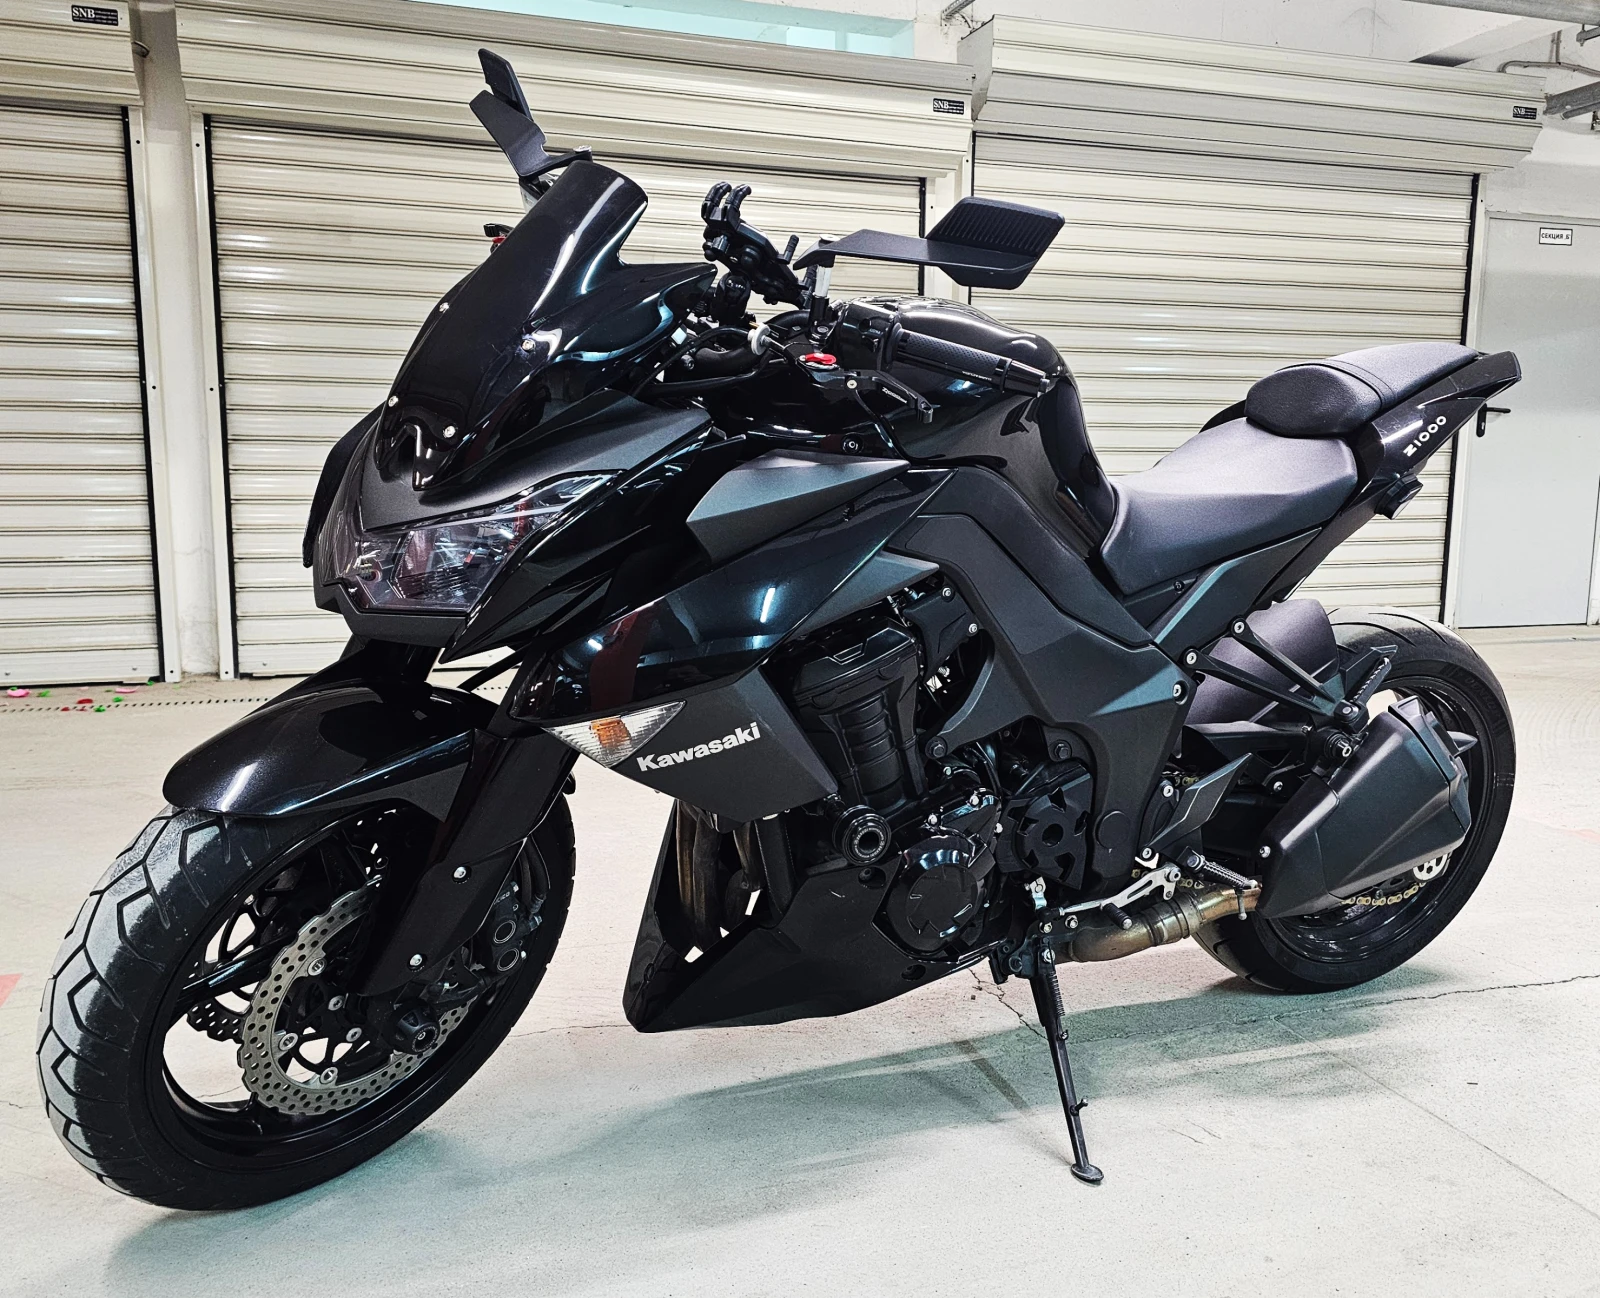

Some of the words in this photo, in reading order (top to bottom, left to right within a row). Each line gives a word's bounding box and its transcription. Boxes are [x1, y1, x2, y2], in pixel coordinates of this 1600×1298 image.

[72, 6, 95, 18] SNB
[933, 99, 949, 109] SNB
[1541, 232, 1564, 240] СЕКЦИЯ
[1402, 415, 1447, 457] Z1000
[636, 721, 761, 771] Kawasaki
